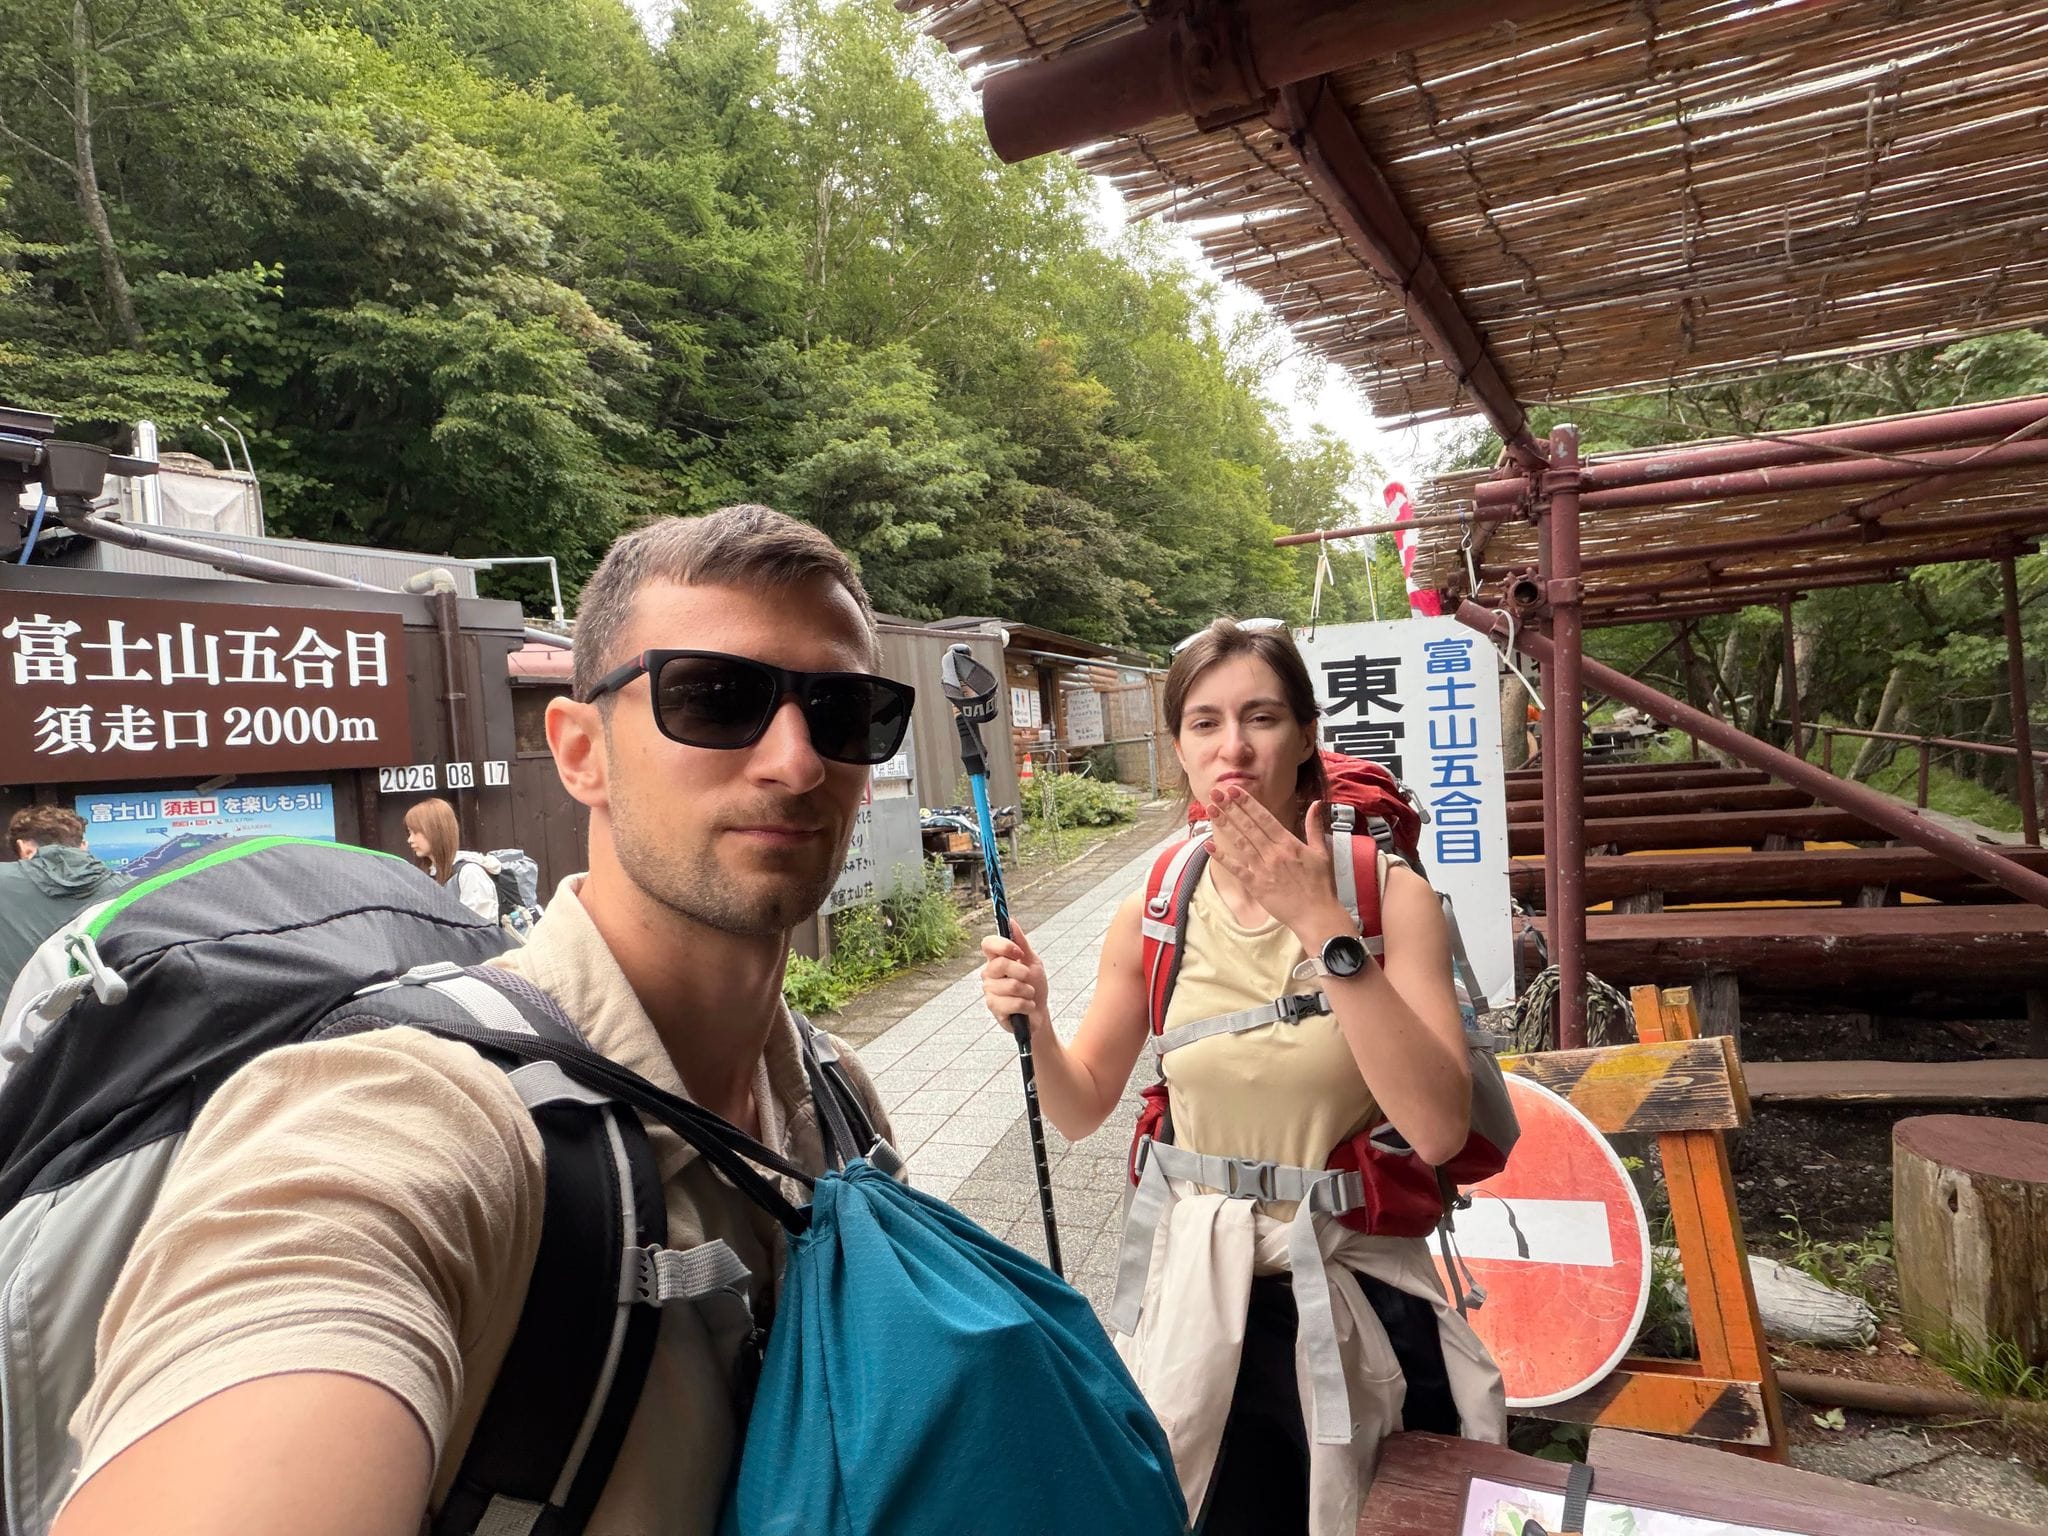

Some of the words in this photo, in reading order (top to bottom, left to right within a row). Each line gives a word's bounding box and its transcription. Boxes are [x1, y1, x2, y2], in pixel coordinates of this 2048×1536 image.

[2, 613, 389, 689] 富士山五合目
[33, 703, 209, 755] 須走口
[223, 706, 379, 746] 2000m
[1423, 638, 1482, 864] 富士山五合目
[380, 766, 434, 791] 2026
[448, 764, 472, 786] 08
[488, 762, 507, 784] 17
[90, 800, 156, 823] 富士山
[164, 800, 216, 817] 須走口
